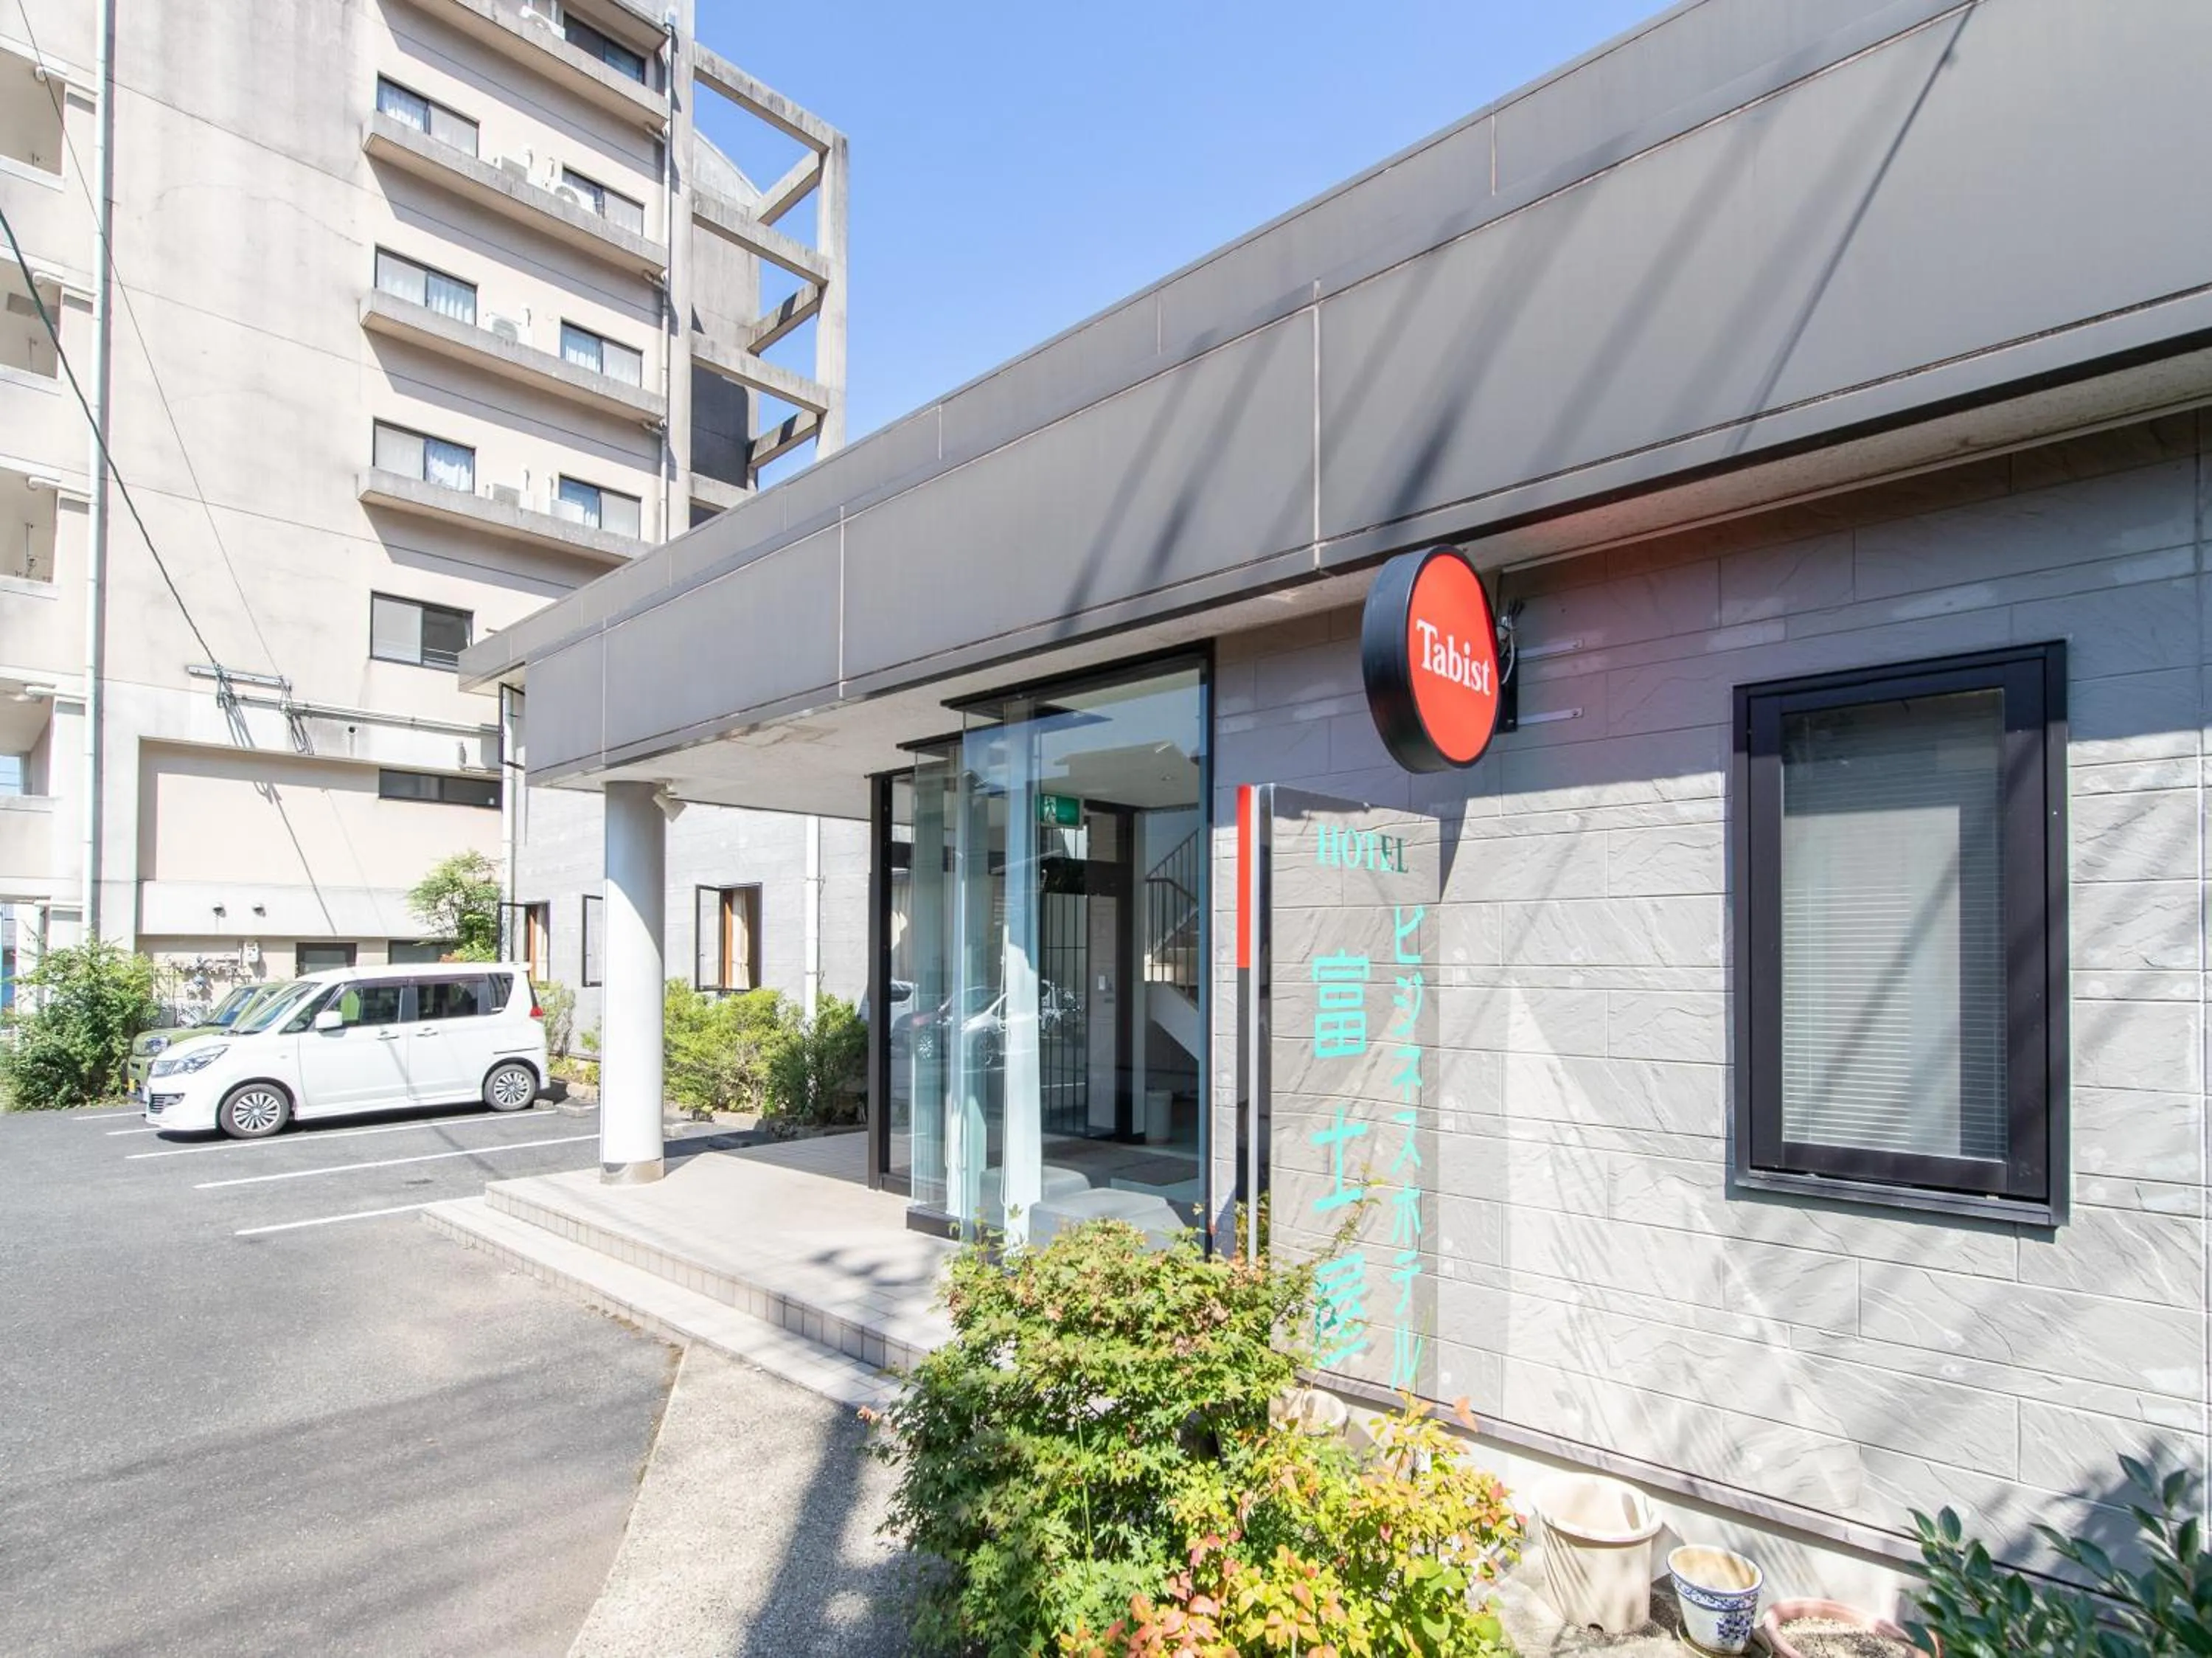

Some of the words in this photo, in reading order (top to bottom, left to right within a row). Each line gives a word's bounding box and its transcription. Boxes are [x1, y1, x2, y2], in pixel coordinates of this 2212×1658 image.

[1416, 618, 1491, 696] Tabist
[1316, 824, 1409, 873] HOTEL
[1312, 949, 1370, 1370] 富士屋
[1391, 903, 1425, 1391] ビジネスホテル
